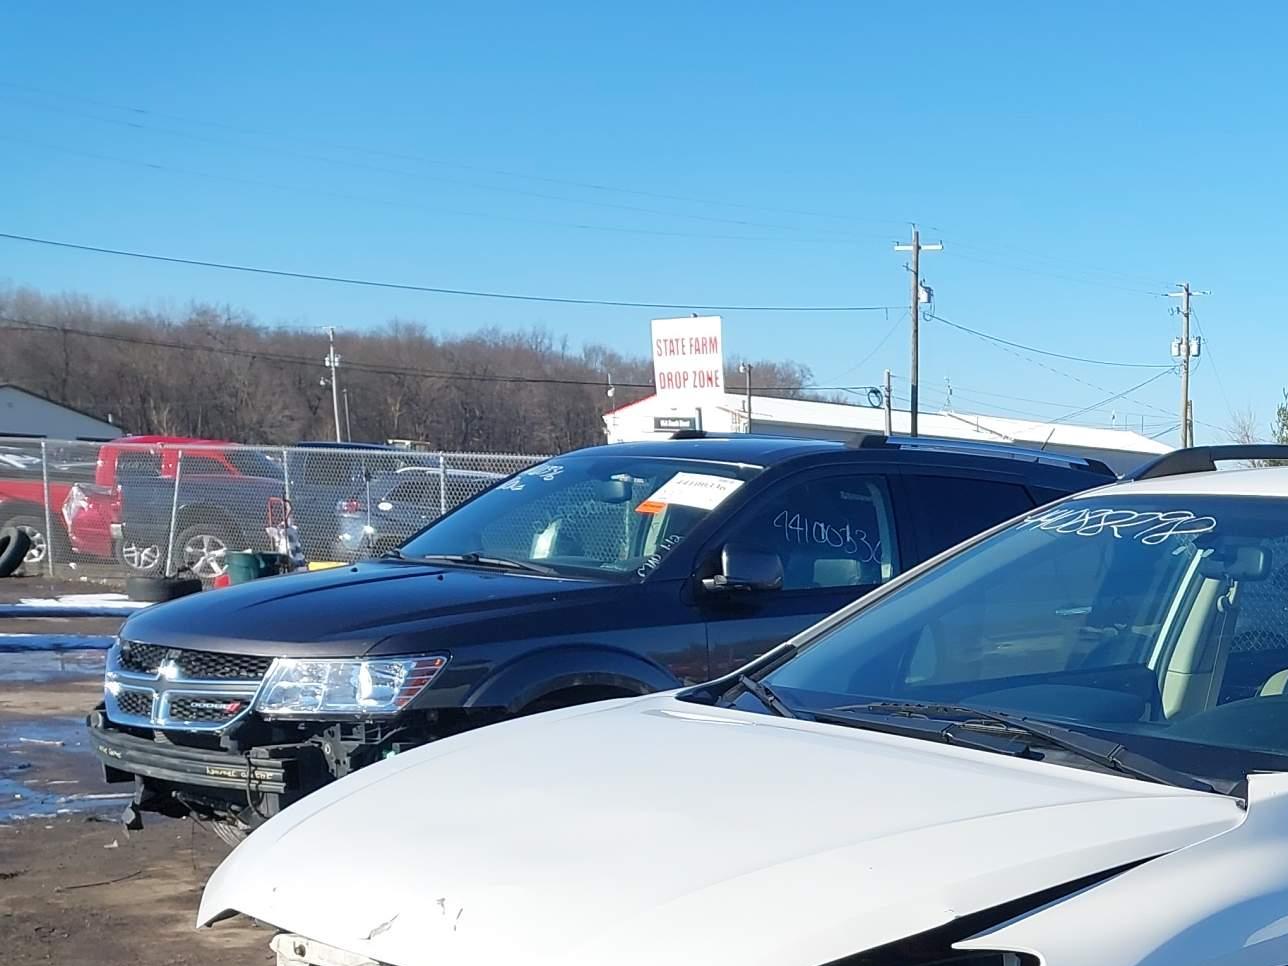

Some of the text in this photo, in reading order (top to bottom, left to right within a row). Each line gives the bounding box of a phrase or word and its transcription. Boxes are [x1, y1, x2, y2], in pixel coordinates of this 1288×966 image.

[656, 335, 718, 356] STATE FARM
[659, 369, 720, 390] DROP ZONE
